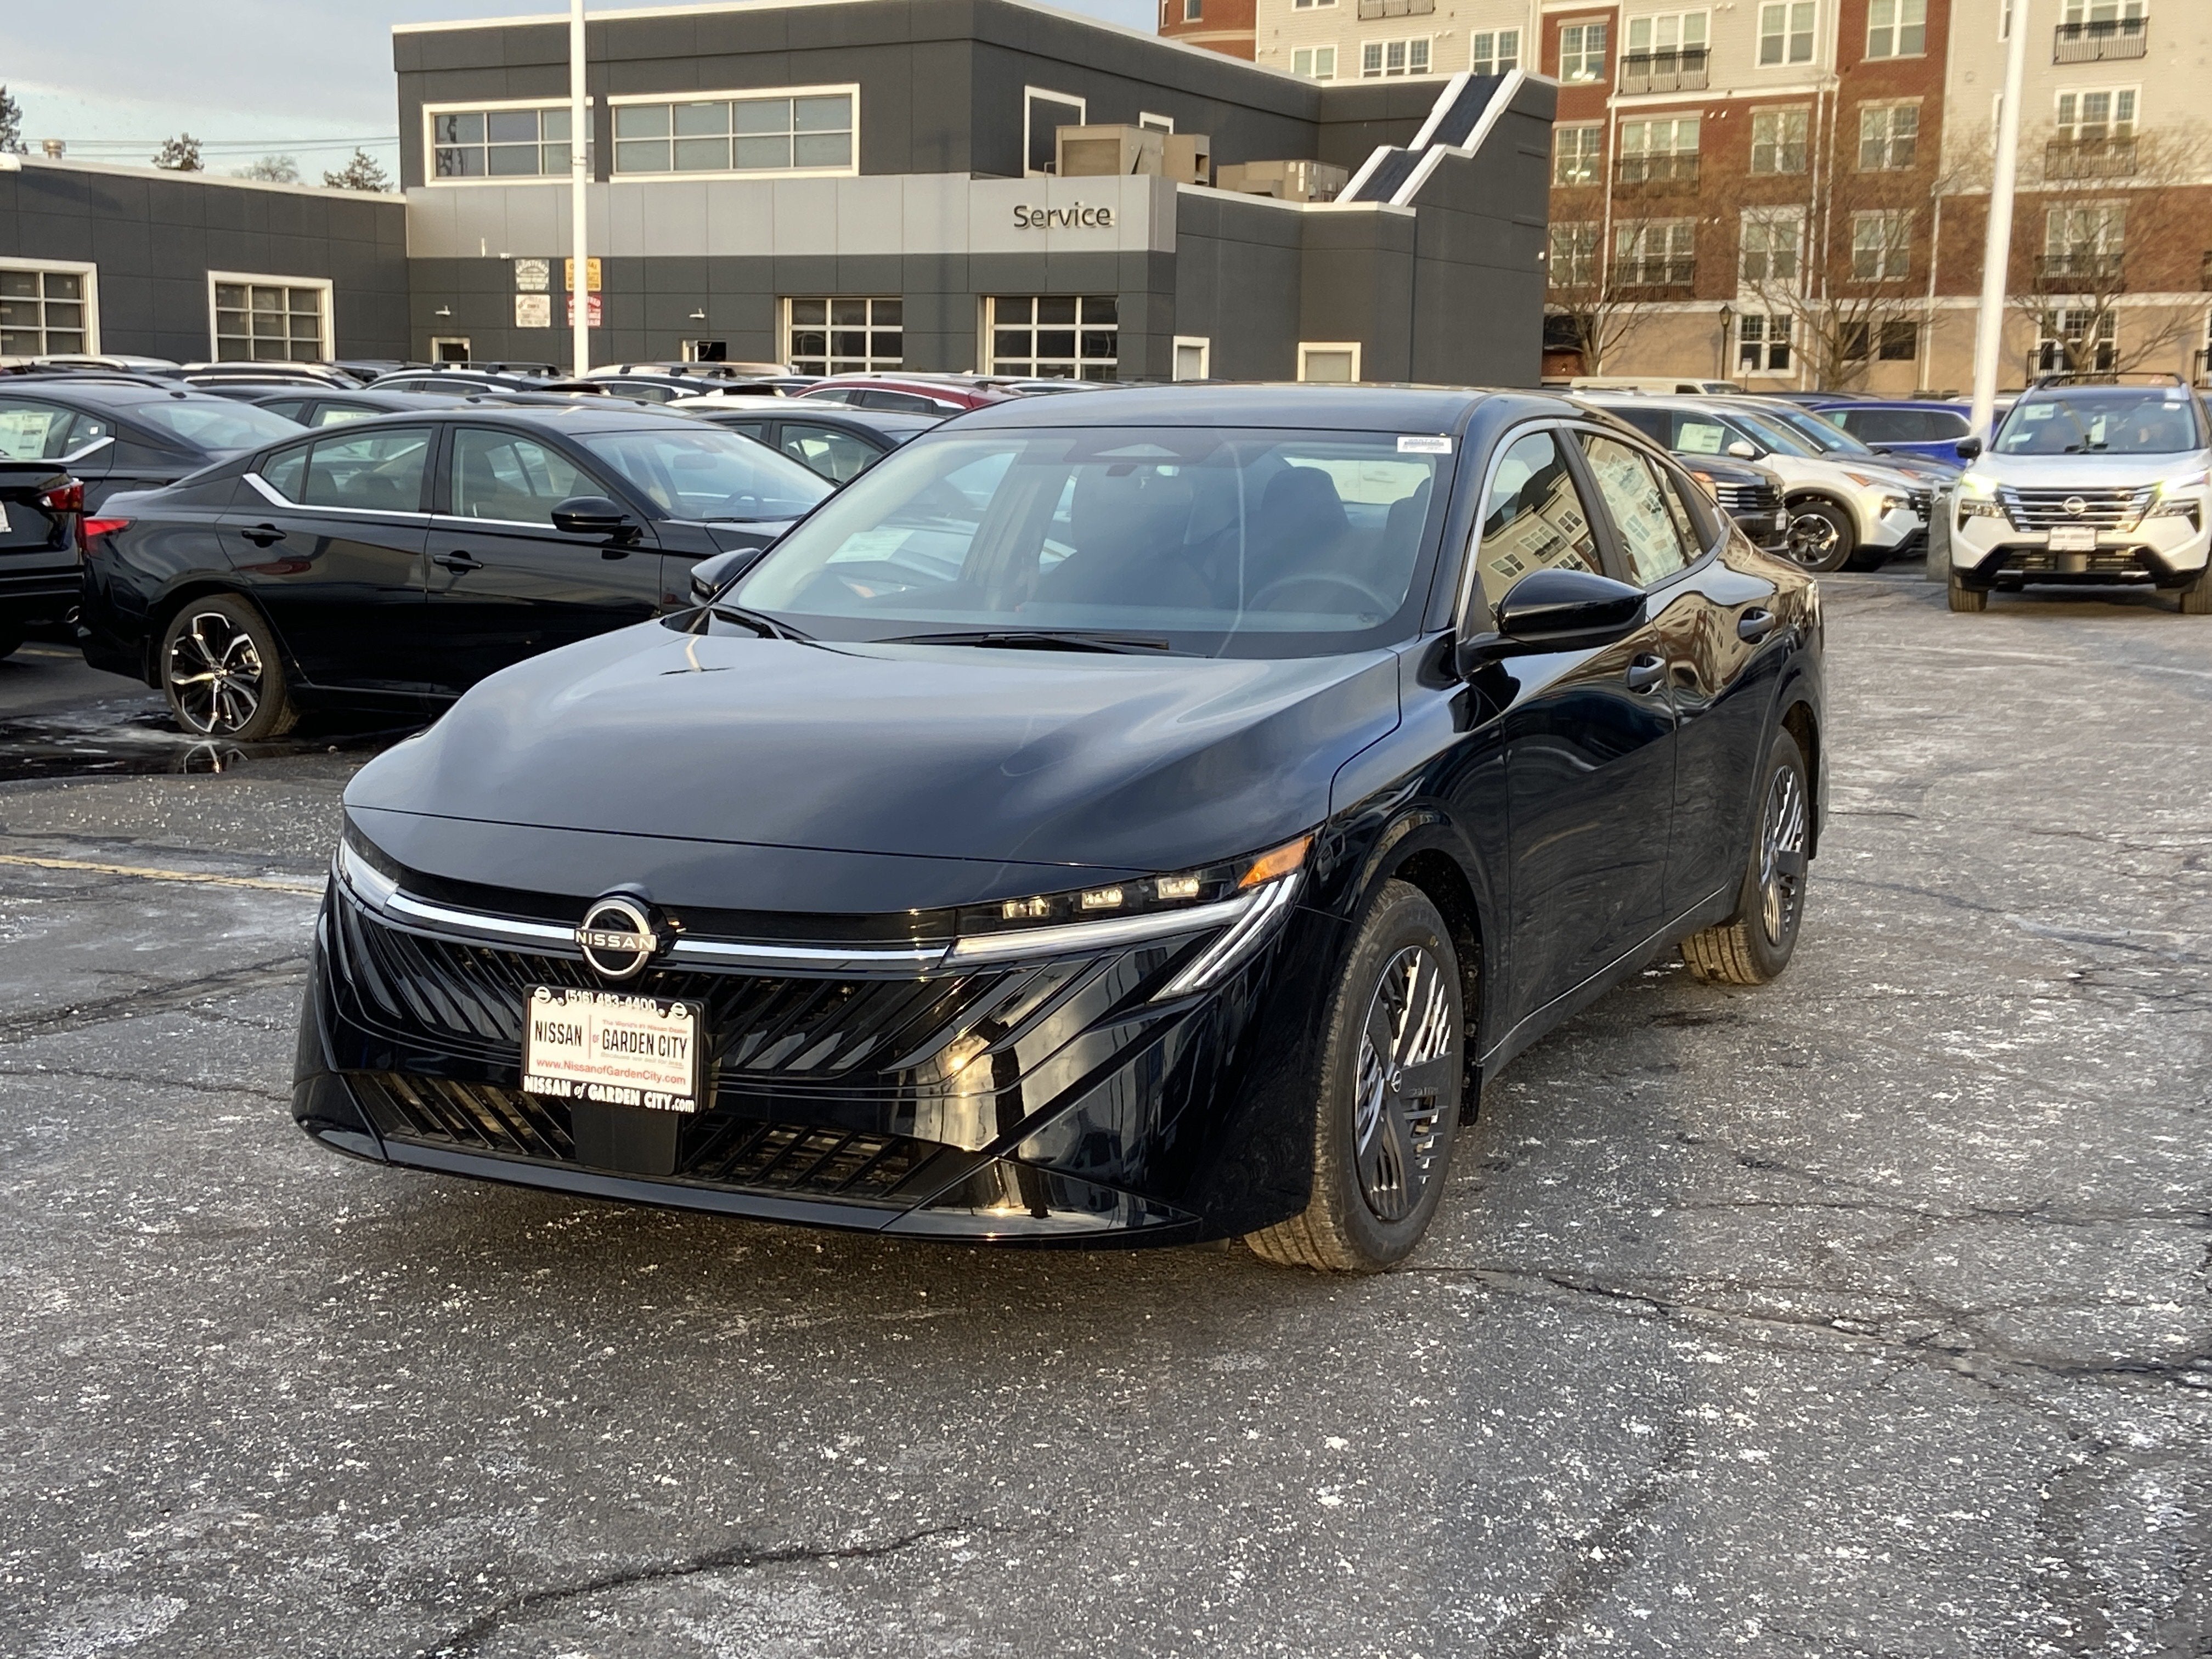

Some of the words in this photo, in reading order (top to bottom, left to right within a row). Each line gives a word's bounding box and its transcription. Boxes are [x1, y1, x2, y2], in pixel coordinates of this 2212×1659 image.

[1014, 202, 1112, 227] Service
[576, 932, 654, 950] NISSAN
[596, 993, 657, 1012] 483-4400
[535, 1020, 582, 1047] NISSAN
[602, 1029, 654, 1056] GARDEN
[658, 1035, 688, 1059] CITY
[537, 1059, 686, 1085] www.NissanofGardenCity.com
[523, 1075, 571, 1097] NISSAN
[574, 1083, 587, 1099] of
[588, 1084, 640, 1106] GARDEN
[644, 1092, 695, 1113] CITY.com
